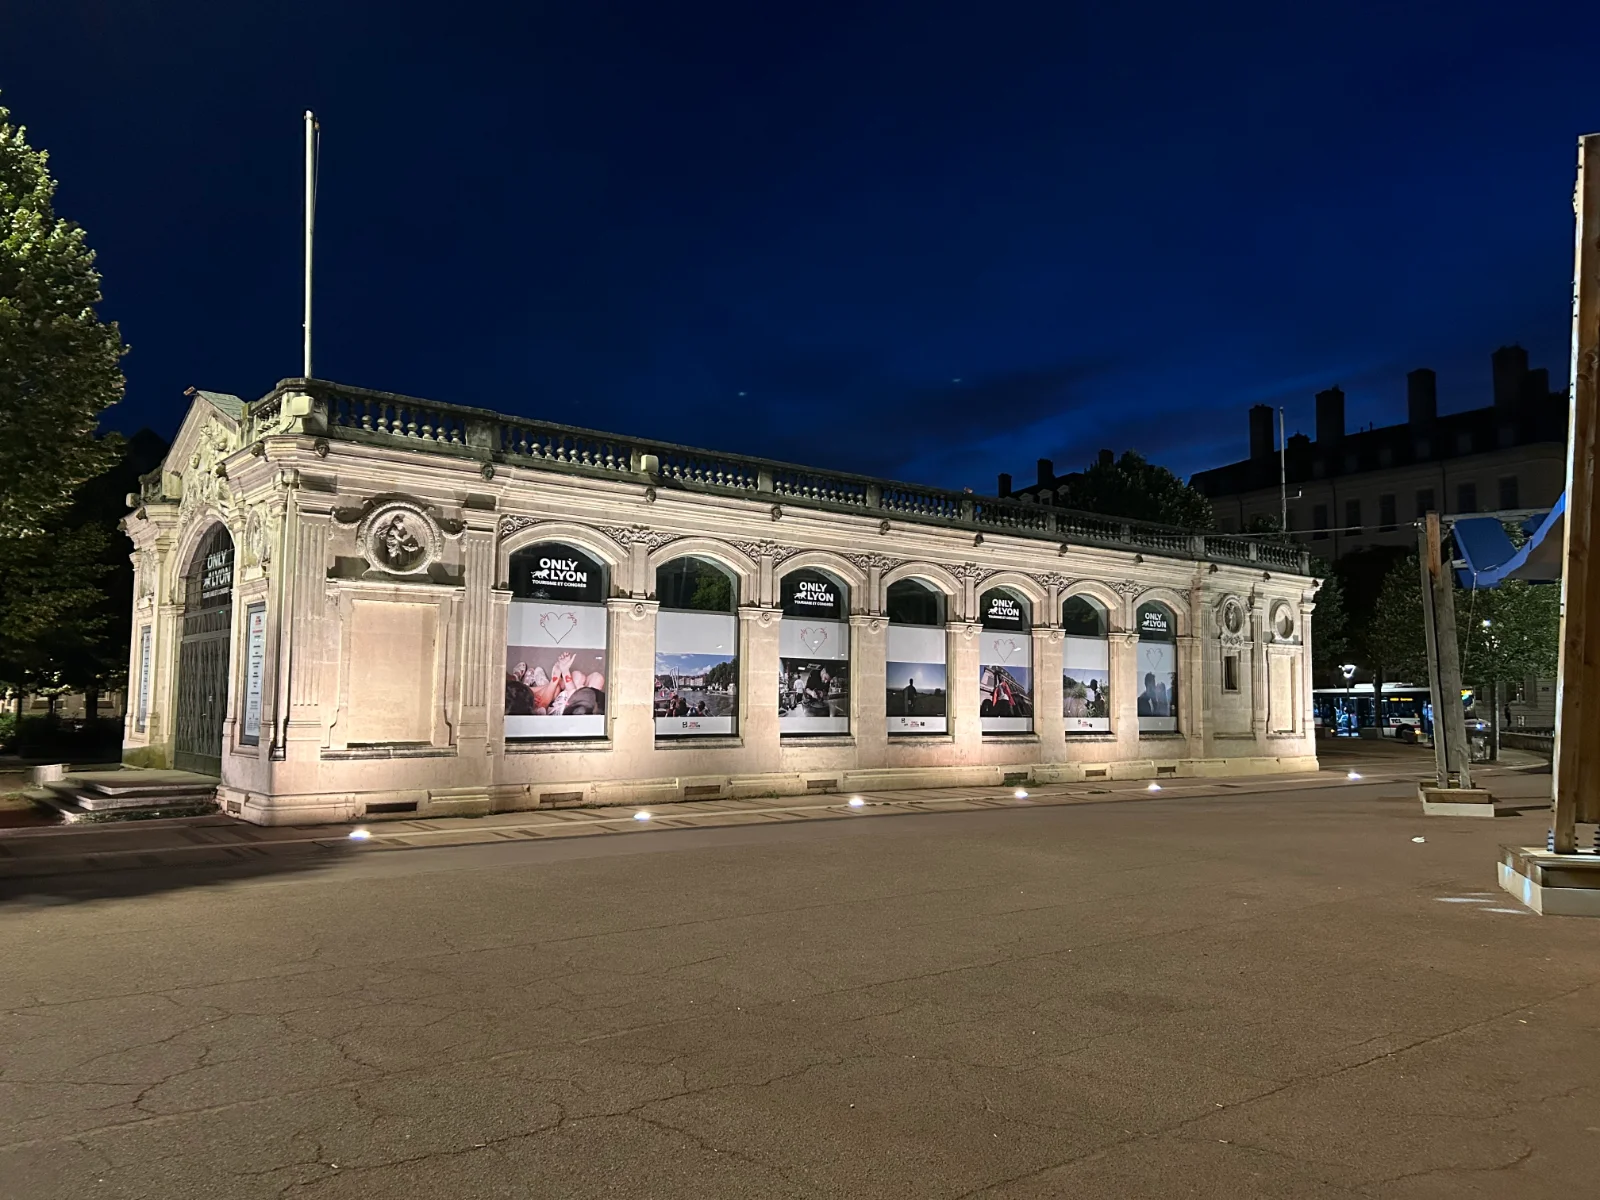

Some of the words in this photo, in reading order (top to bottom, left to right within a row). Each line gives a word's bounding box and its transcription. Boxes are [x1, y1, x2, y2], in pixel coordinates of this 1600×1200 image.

[208, 550, 227, 570] ONLY
[540, 558, 578, 570] ONLY
[212, 567, 230, 586] LYON
[550, 570, 587, 582] LYON
[800, 582, 828, 592] ONLY
[808, 592, 834, 602] LYON
[992, 598, 1014, 608] ONLY
[998, 608, 1020, 616] LYON
[1144, 612, 1162, 620] ONLY
